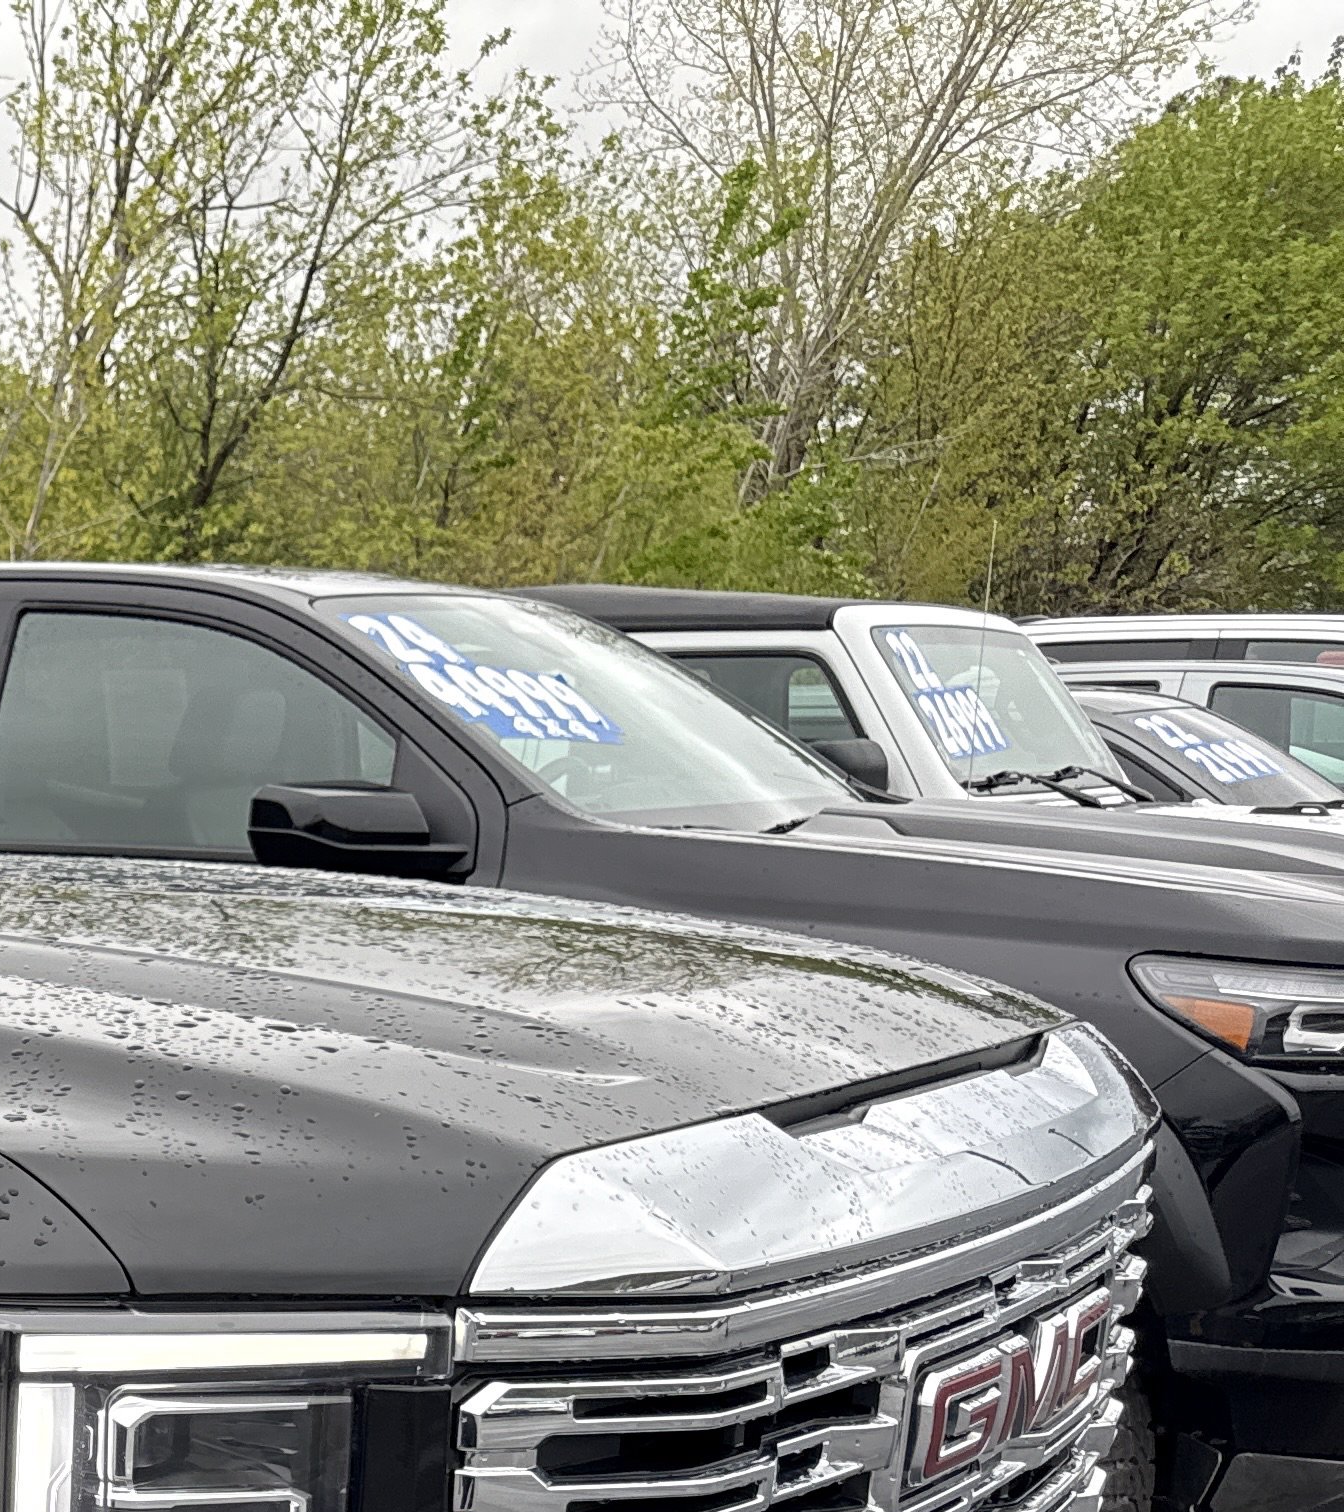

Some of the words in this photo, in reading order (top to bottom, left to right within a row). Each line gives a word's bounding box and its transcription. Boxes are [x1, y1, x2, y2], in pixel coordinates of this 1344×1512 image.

[348, 614, 465, 664] 24
[886, 631, 944, 691] 22
[917, 688, 1007, 757] 26999
[1134, 714, 1203, 749] 22
[910, 1286, 1112, 1486] GMC
